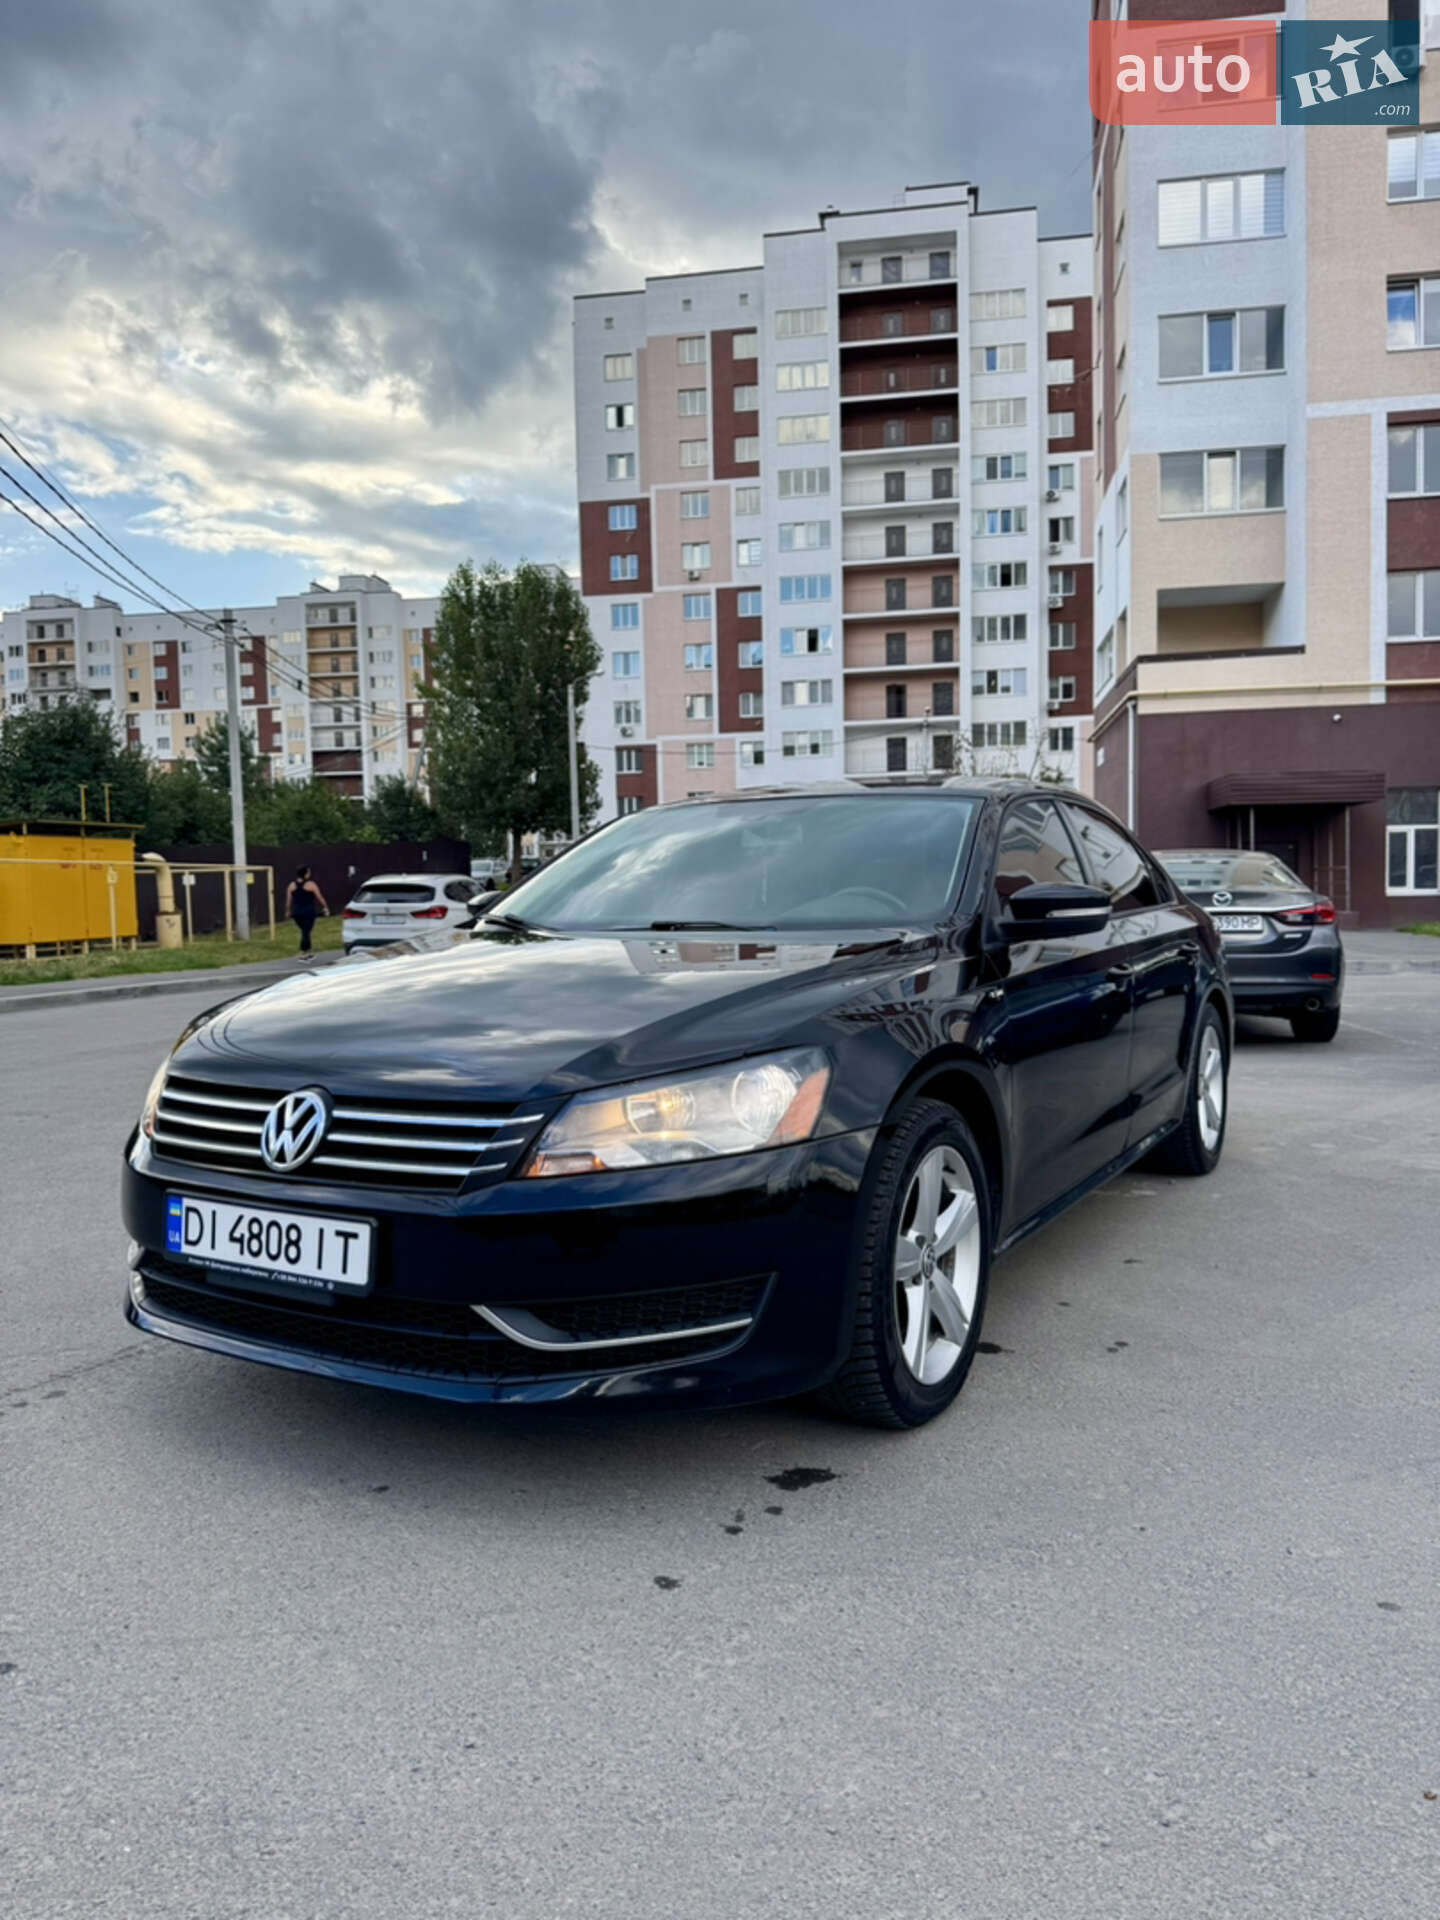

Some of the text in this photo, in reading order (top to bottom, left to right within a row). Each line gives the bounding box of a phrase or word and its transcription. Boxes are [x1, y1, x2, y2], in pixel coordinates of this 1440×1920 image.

[261, 1090, 326, 1172] VW
[168, 1230, 181, 1243] UA
[184, 1205, 216, 1251] DI
[228, 1214, 303, 1265] 4808
[317, 1227, 359, 1275] IT
